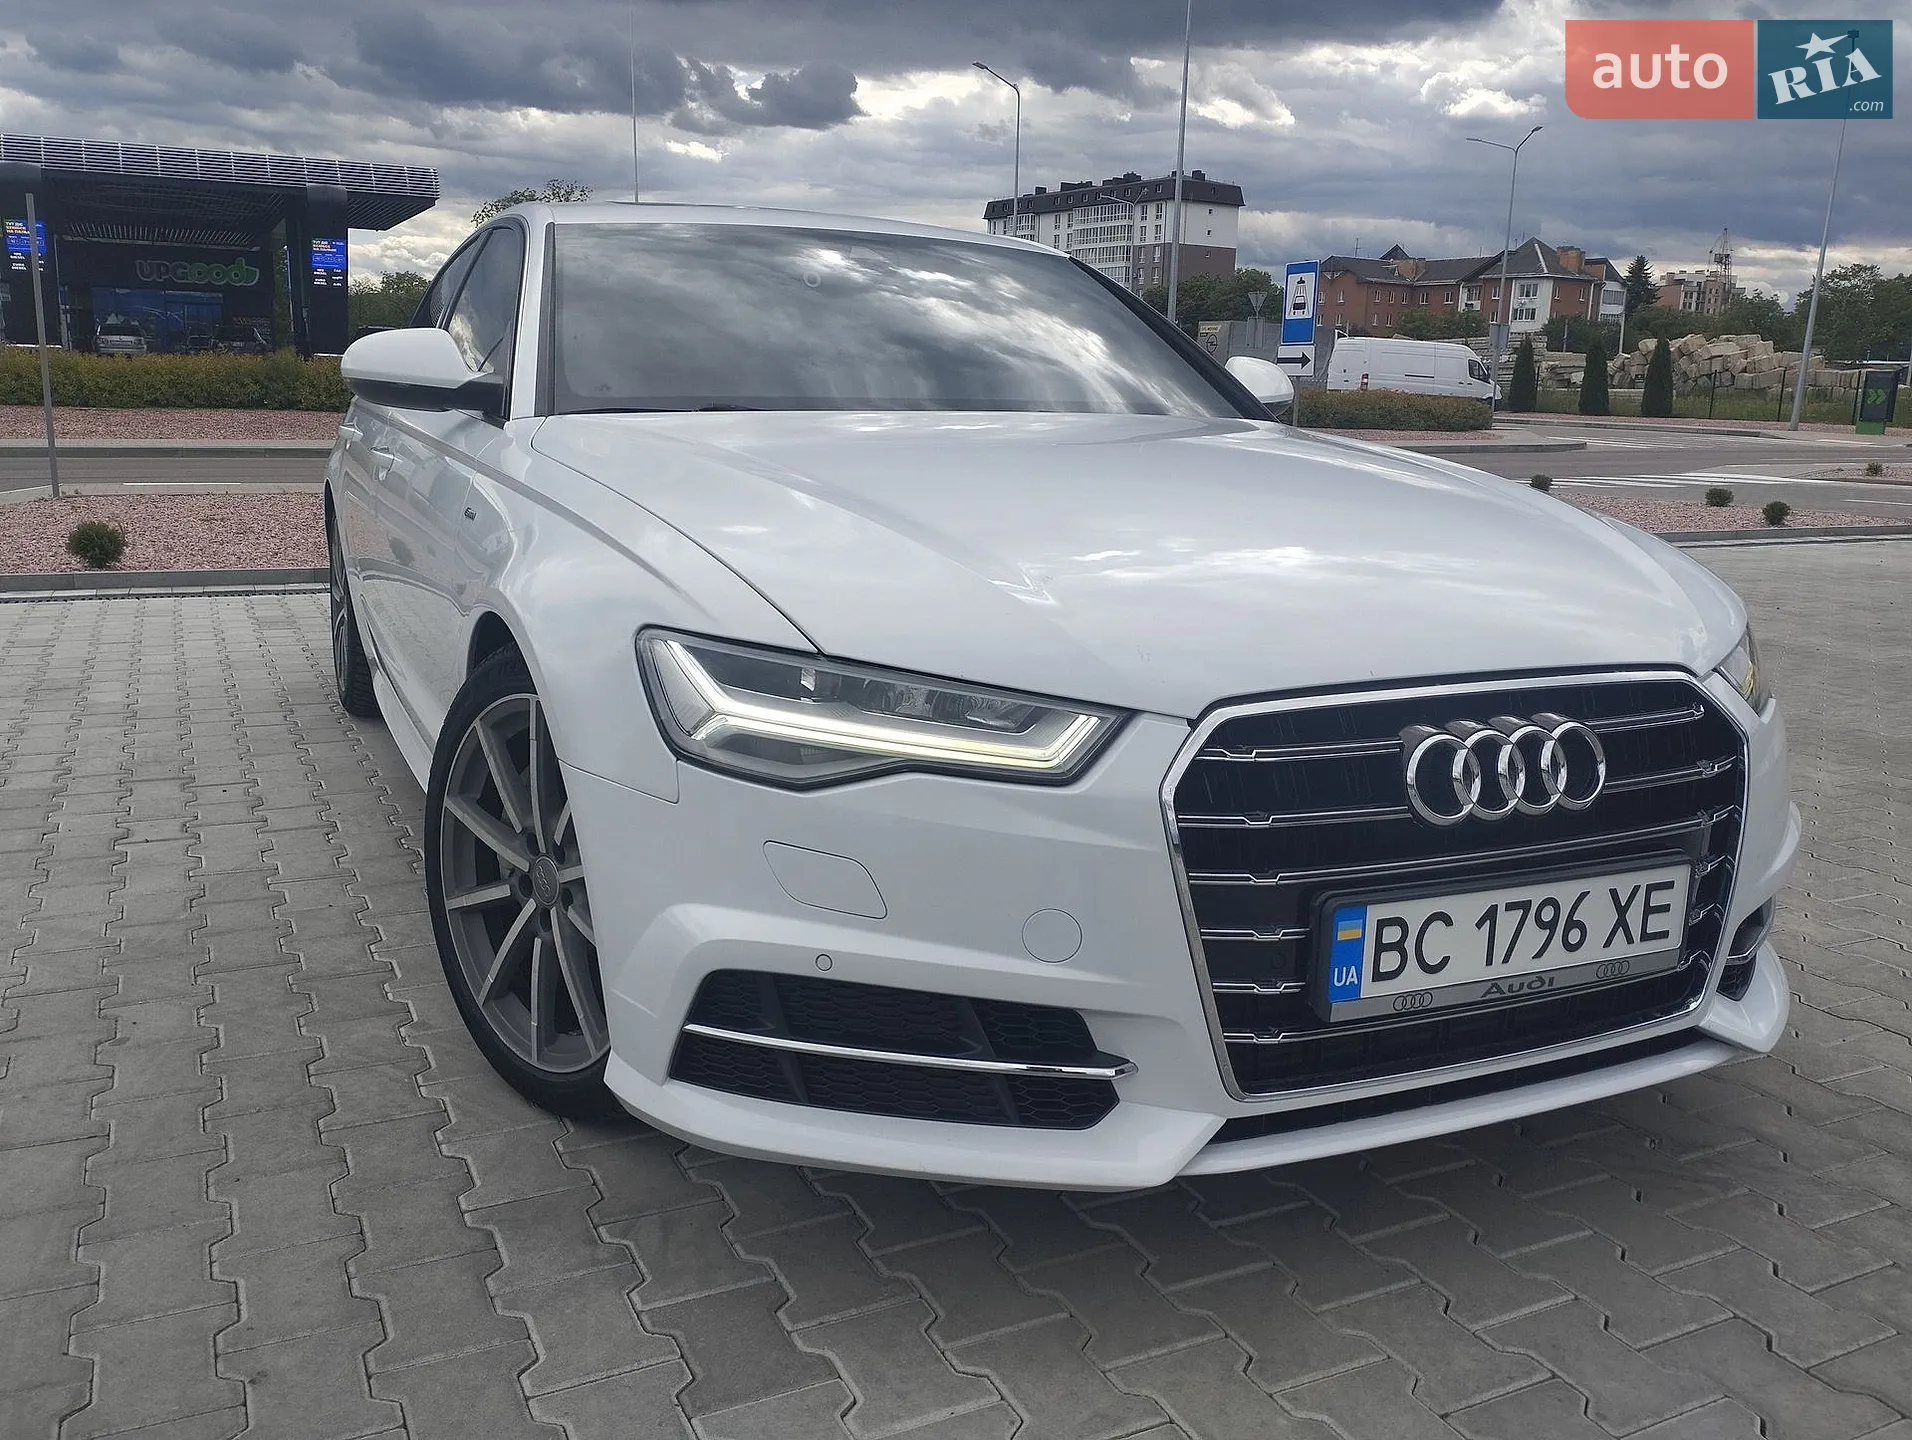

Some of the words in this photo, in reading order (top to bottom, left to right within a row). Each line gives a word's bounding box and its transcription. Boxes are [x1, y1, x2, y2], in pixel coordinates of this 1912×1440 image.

[1371, 910, 1454, 983] BC
[1474, 890, 1591, 967] 1796
[1601, 880, 1676, 949] XE
[1334, 965, 1358, 987] UA
[1480, 976, 1556, 998] Audi
